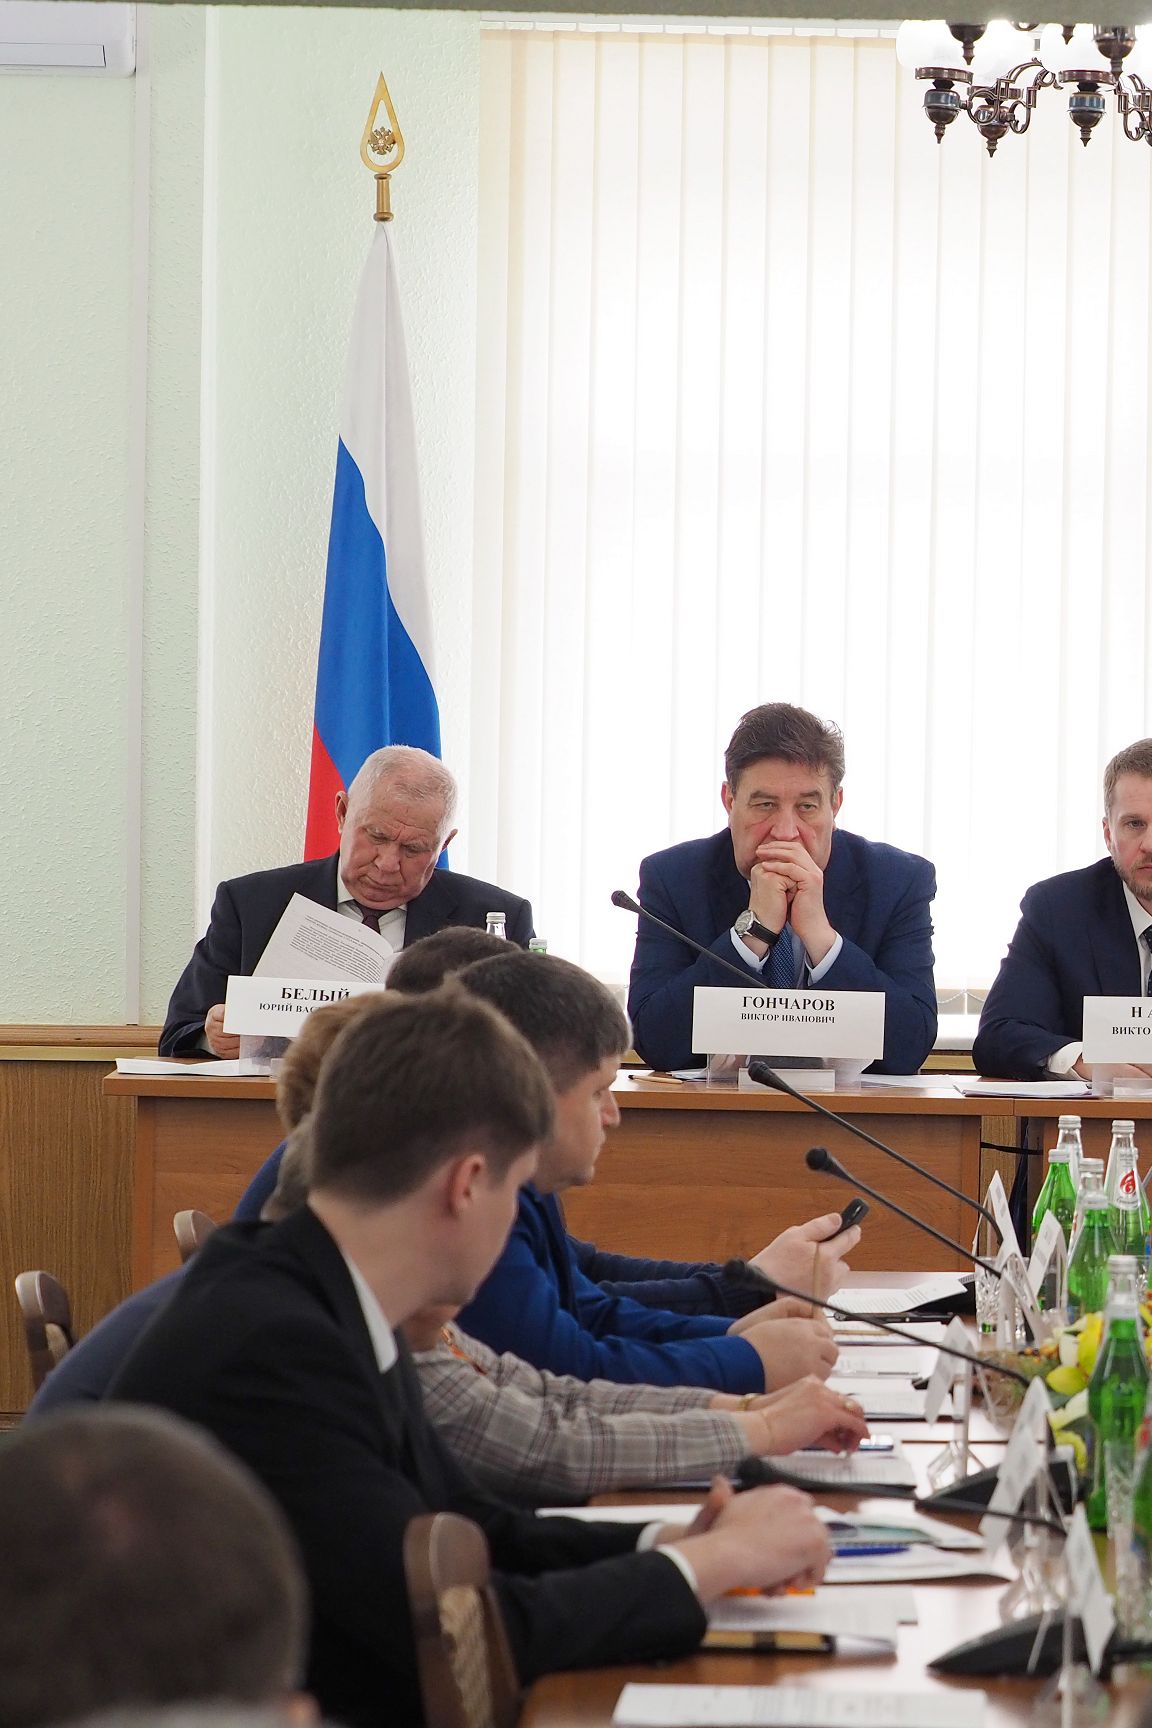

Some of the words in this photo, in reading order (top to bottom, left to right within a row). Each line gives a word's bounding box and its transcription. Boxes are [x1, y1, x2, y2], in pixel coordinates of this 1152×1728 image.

[281, 987, 350, 1002] БЕЛЫЙ
[259, 1002, 292, 1012] ЮРИЙ
[296, 1004, 319, 1013] ВАС
[742, 996, 835, 1011] ГОНЧАРОВ
[741, 1012, 779, 1021] ВИКТОР
[781, 1014, 835, 1024] ИВАНОВИЧ
